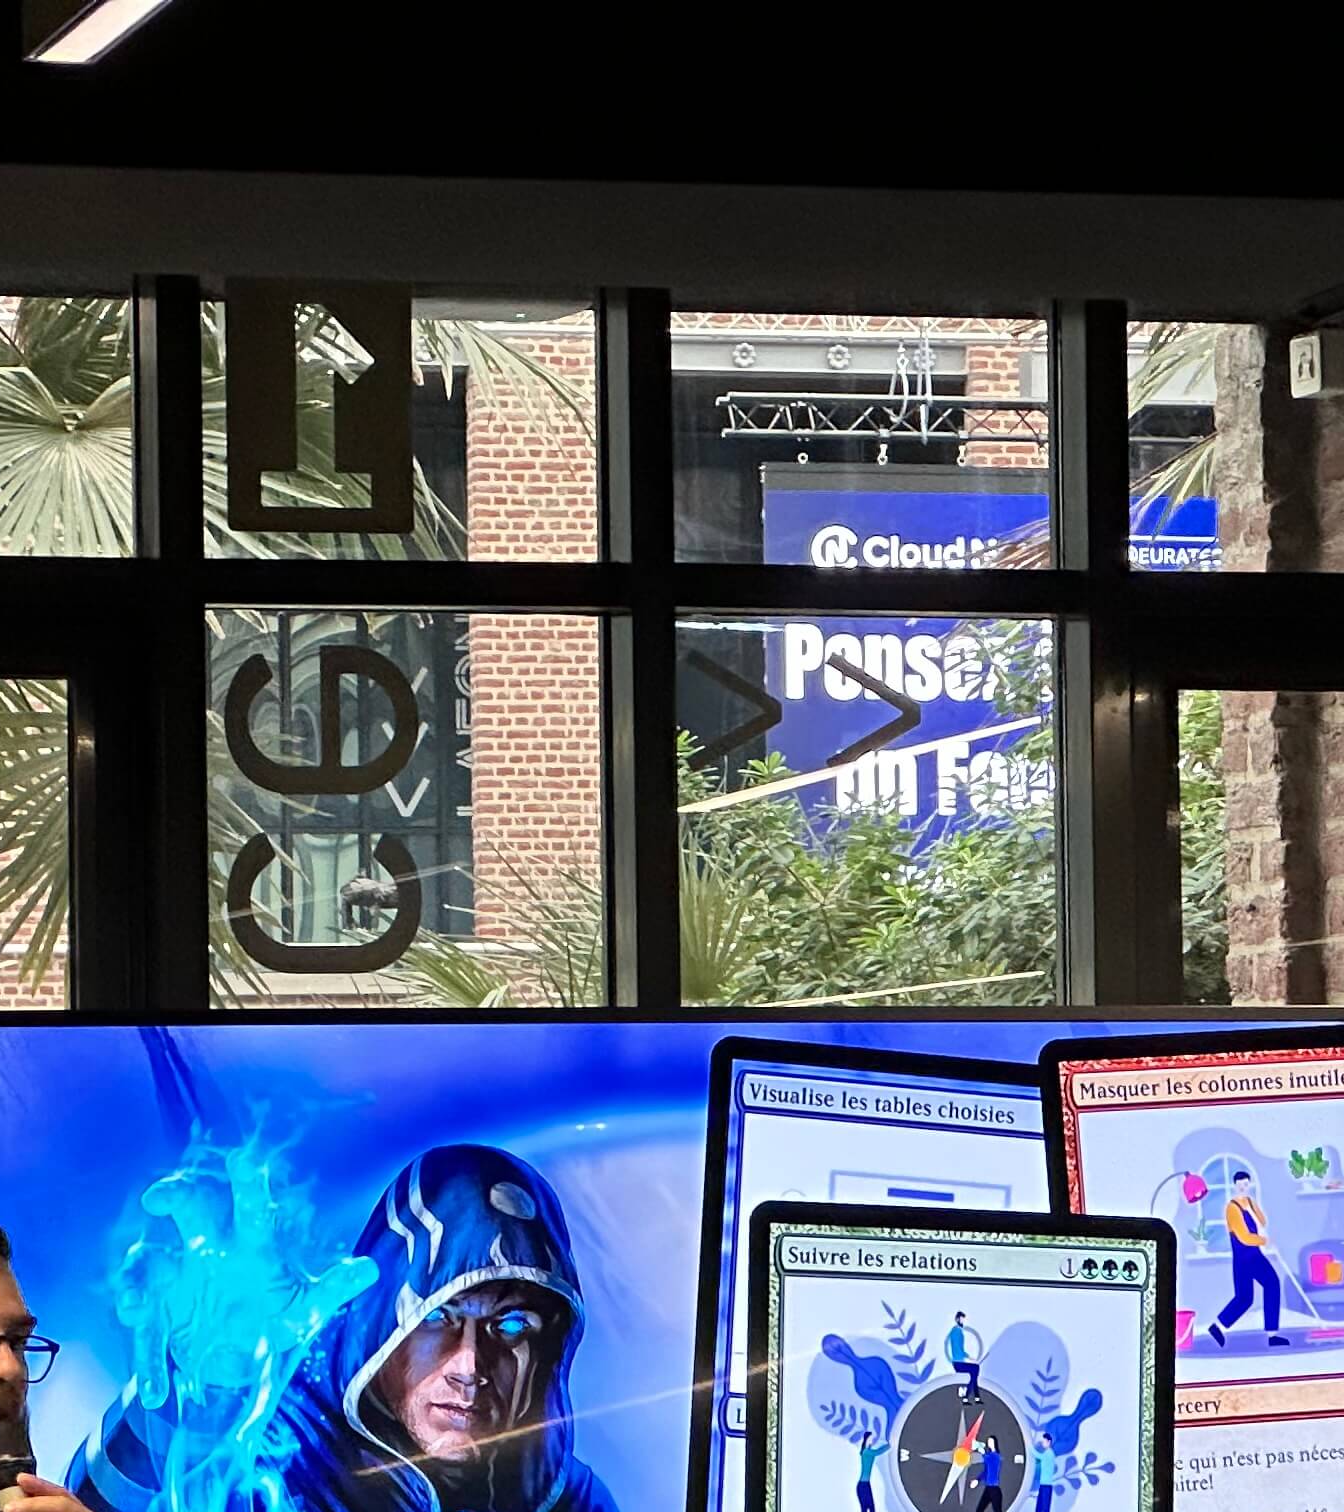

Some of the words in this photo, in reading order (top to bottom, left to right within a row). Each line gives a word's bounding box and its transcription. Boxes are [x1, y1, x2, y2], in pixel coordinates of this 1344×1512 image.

[1080, 1081, 1160, 1101] Masquer
[1167, 1076, 1192, 1095] les
[1198, 1073, 1283, 1093] colonnes
[749, 1082, 834, 1108] Visualise
[841, 1090, 868, 1111] les
[875, 1094, 932, 1117] tables
[938, 1101, 1015, 1125] choisies
[787, 1246, 851, 1267] Suivre
[857, 1248, 885, 1269] les
[890, 1251, 977, 1272] relations
[1176, 1399, 1222, 1416] rcery
[1189, 1454, 1218, 1473] qui
[1222, 1450, 1260, 1469] n'est
[1266, 1452, 1294, 1469] pas
